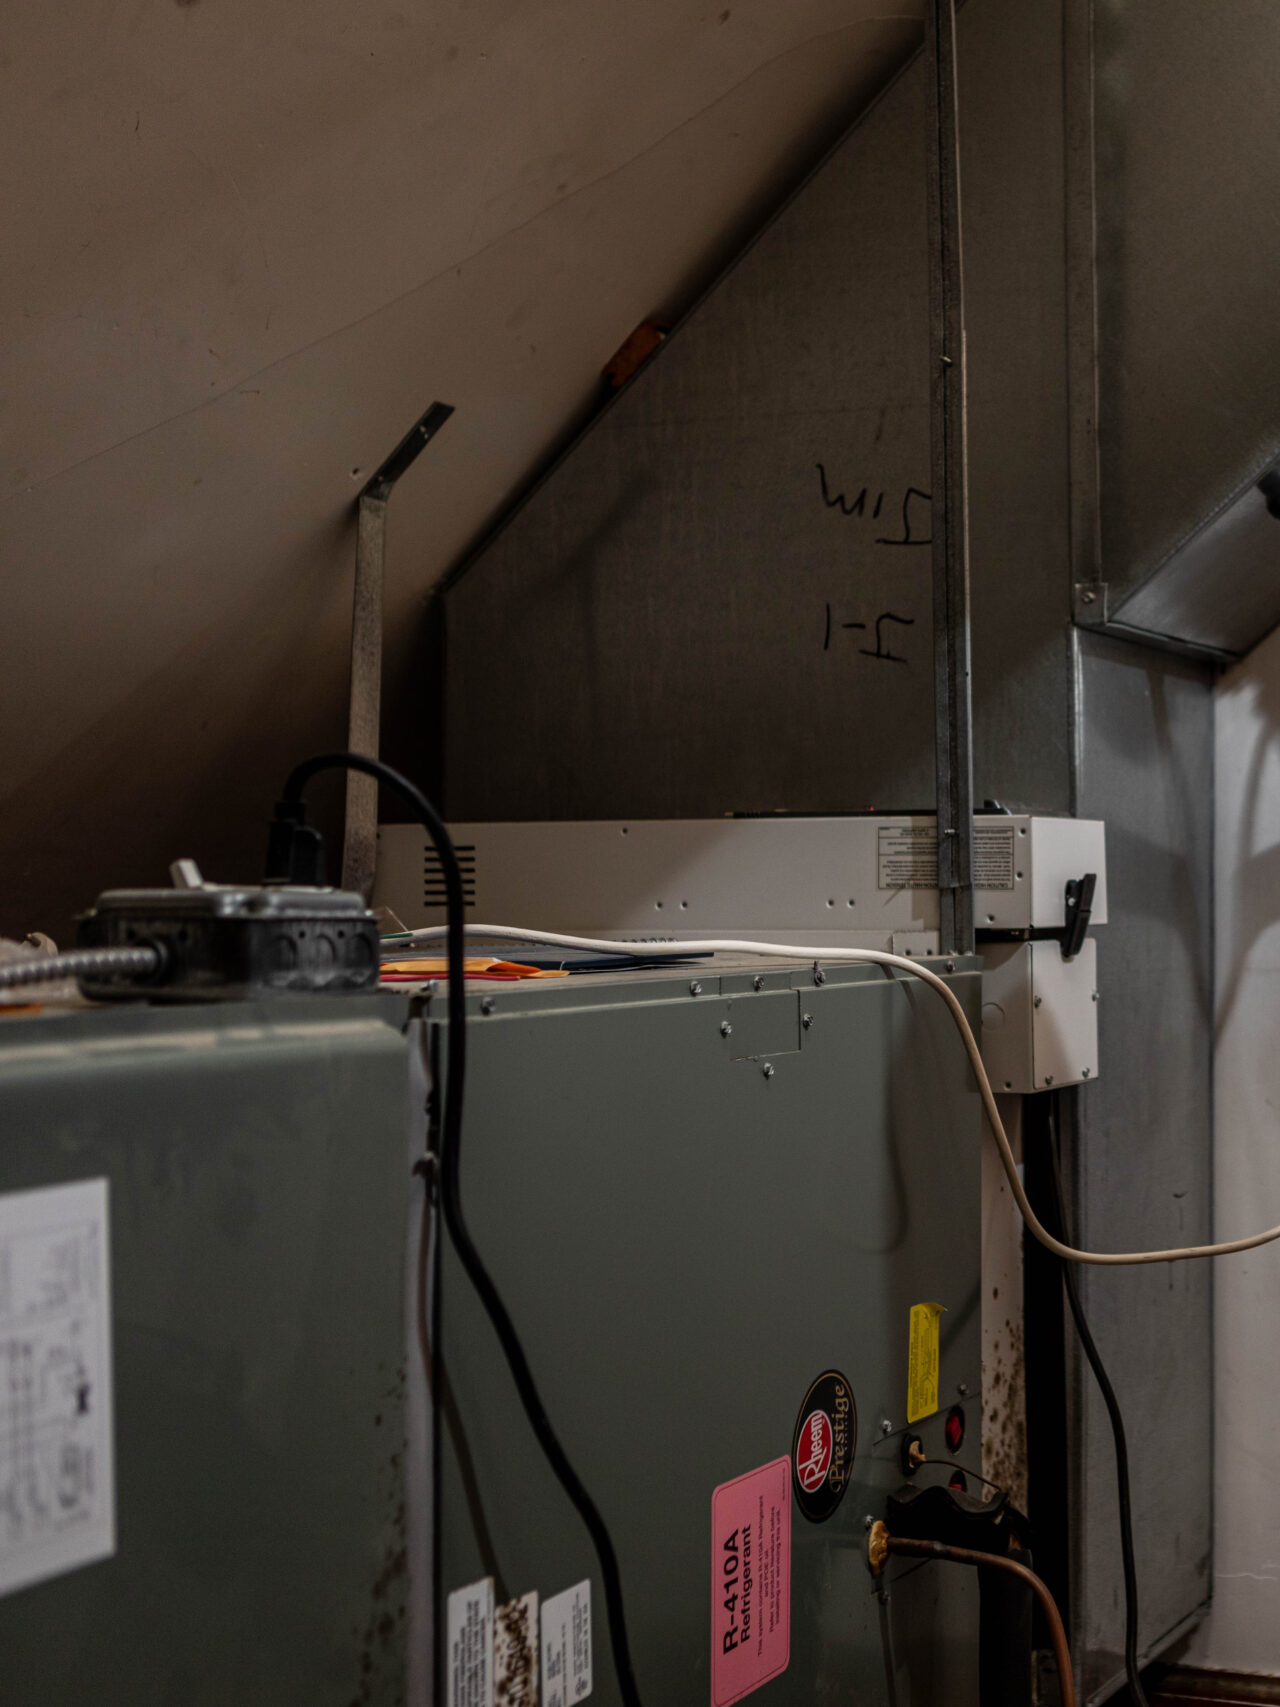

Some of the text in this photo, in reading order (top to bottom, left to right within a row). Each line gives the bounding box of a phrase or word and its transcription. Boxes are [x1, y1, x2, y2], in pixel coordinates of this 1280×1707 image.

[799, 1412, 828, 1486] Rheem
[829, 1385, 849, 1493] Prestige
[723, 1528, 739, 1655] R-410A
[740, 1524, 752, 1642] Refrigerant
